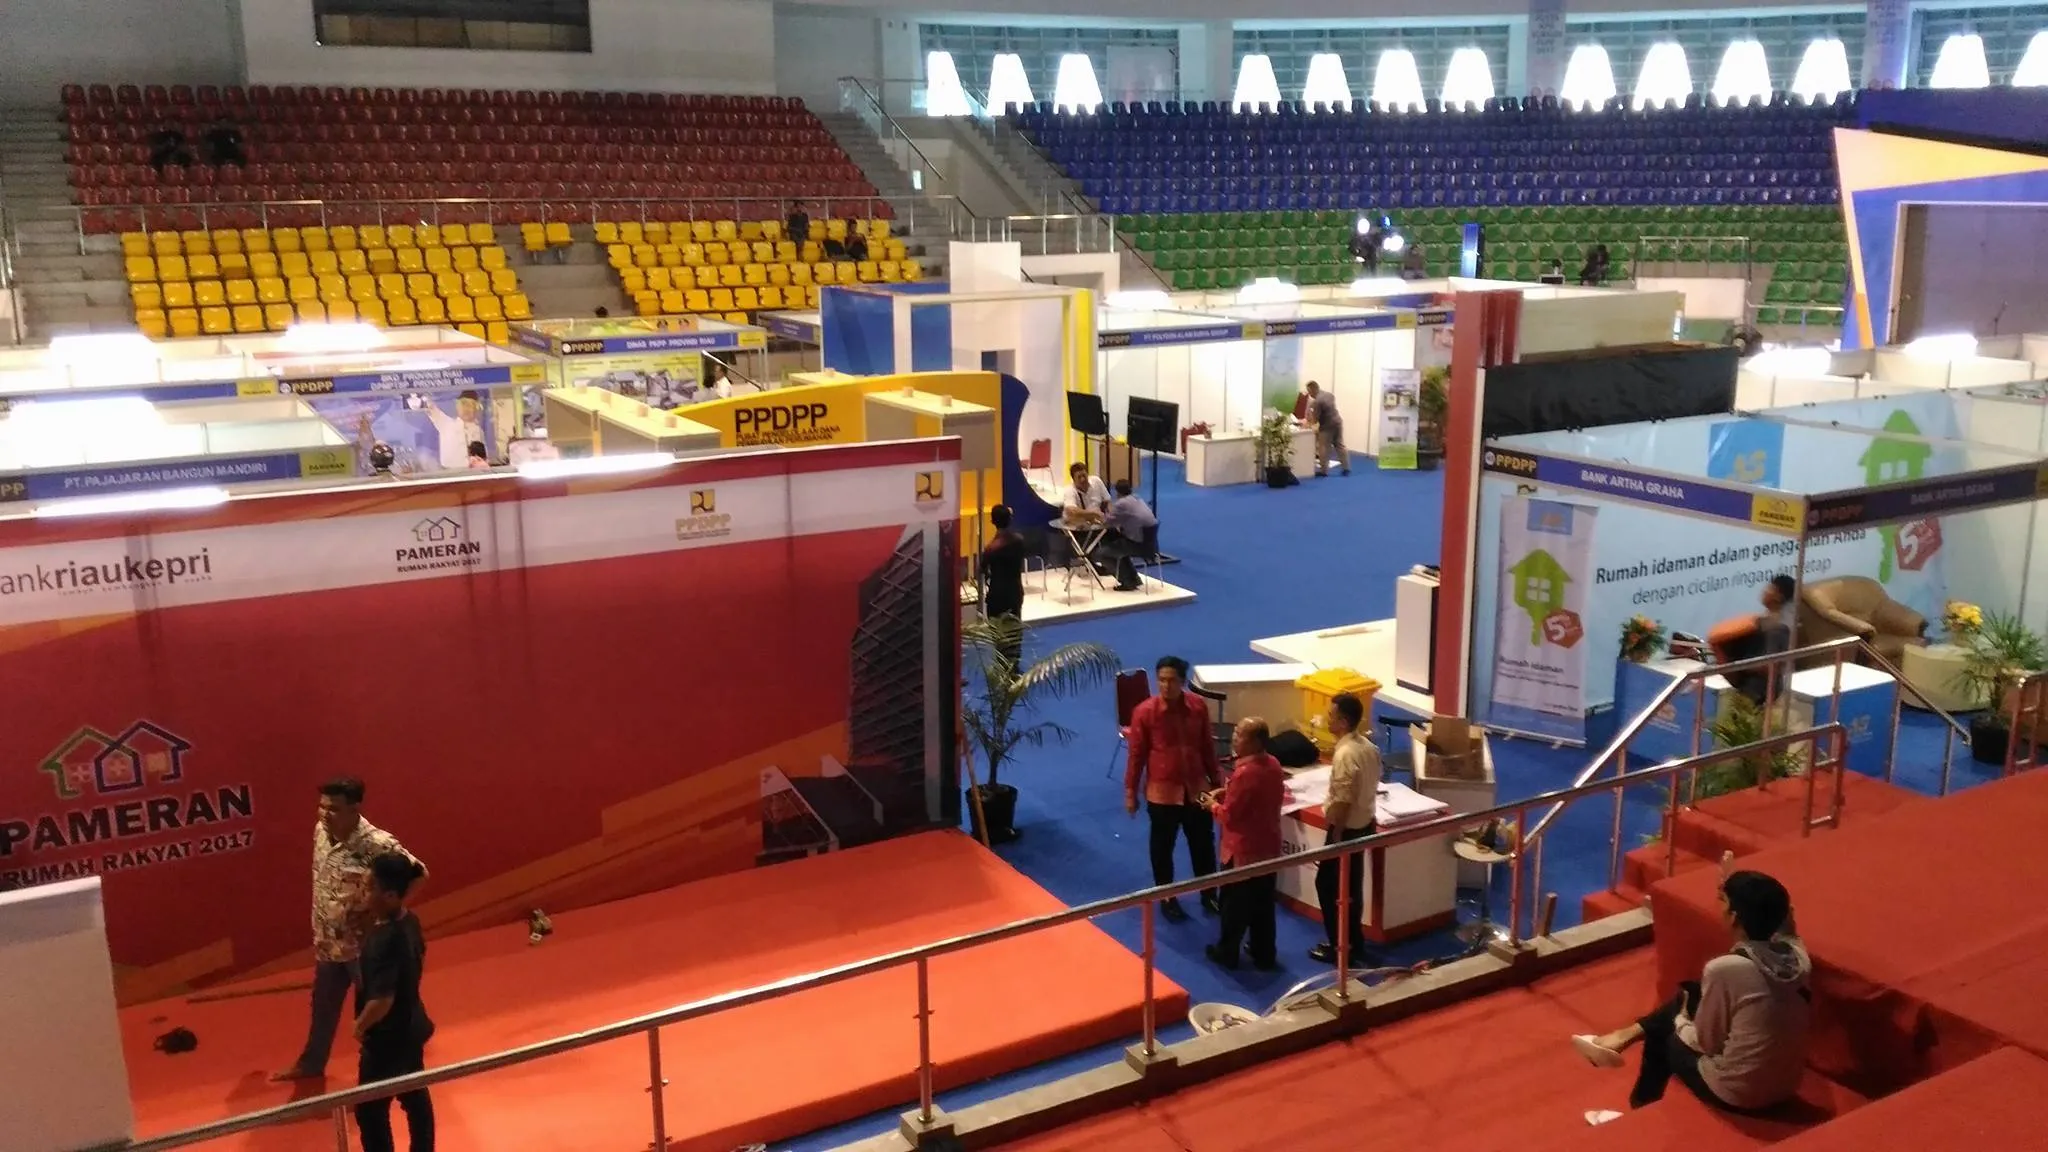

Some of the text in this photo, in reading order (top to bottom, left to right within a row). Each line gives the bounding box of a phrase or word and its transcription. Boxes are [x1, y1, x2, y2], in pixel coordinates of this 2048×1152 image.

[292, 381, 334, 393] PPDPP
[453, 376, 475, 387] RIAU
[735, 403, 828, 433] PPDPP
[84, 470, 162, 488] PAJAJARAN
[162, 465, 215, 481] BANGUN
[215, 462, 268, 477] MANDIRI
[1496, 454, 1537, 473] PPDPP
[1581, 469, 1685, 499] BANK ARTHA GRAHA
[396, 541, 480, 561] PAMERAN
[1596, 560, 1649, 585] Rumah
[1652, 553, 1705, 576] idaman
[1708, 545, 1750, 567] dalam
[397, 562, 428, 573] RUMAH
[429, 560, 460, 570] RAKYAT
[1632, 581, 1685, 606] dengan
[1687, 574, 1730, 595] cicilan
[1731, 568, 1774, 592] ringan
[0, 785, 253, 857] PAMERAN
[103, 841, 193, 872] RAKYAT
[199, 831, 254, 854] 2017
